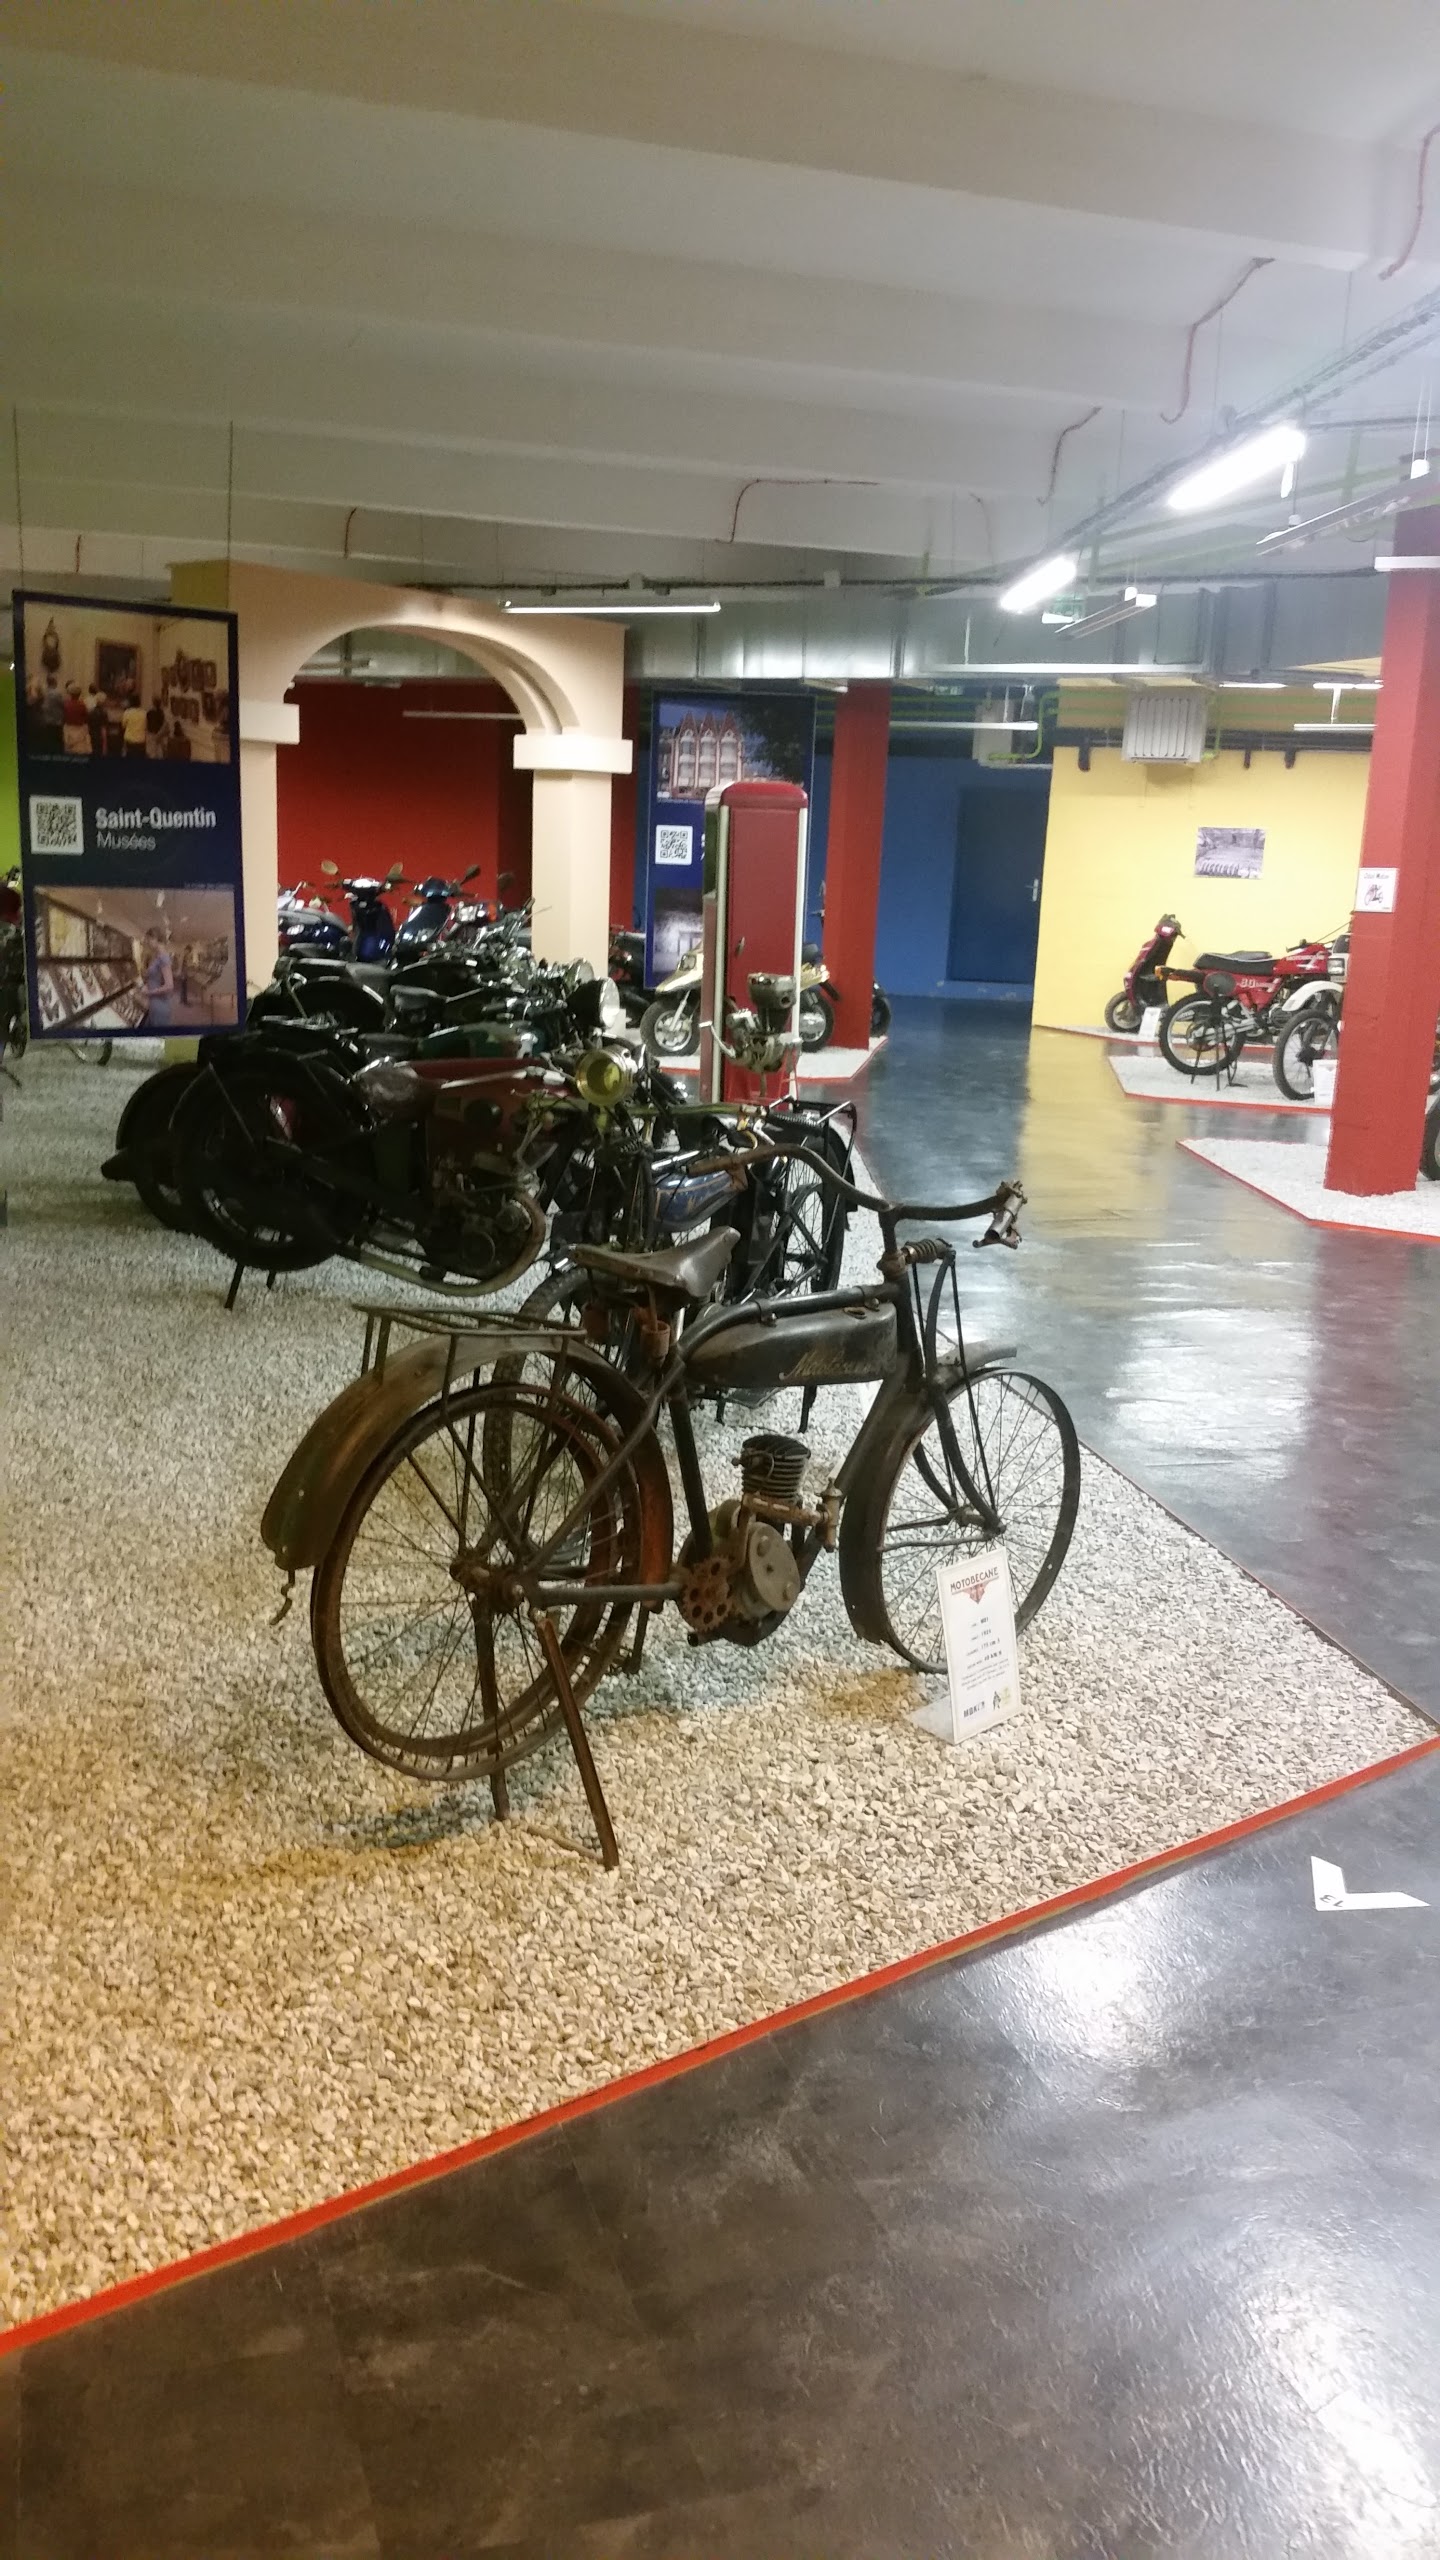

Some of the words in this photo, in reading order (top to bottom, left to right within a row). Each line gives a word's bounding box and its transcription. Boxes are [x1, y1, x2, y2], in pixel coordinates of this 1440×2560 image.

[95, 806, 217, 829] Saint-Quentin
[96, 830, 157, 851] Musées
[950, 1566, 999, 1593] MOTOBECANE
